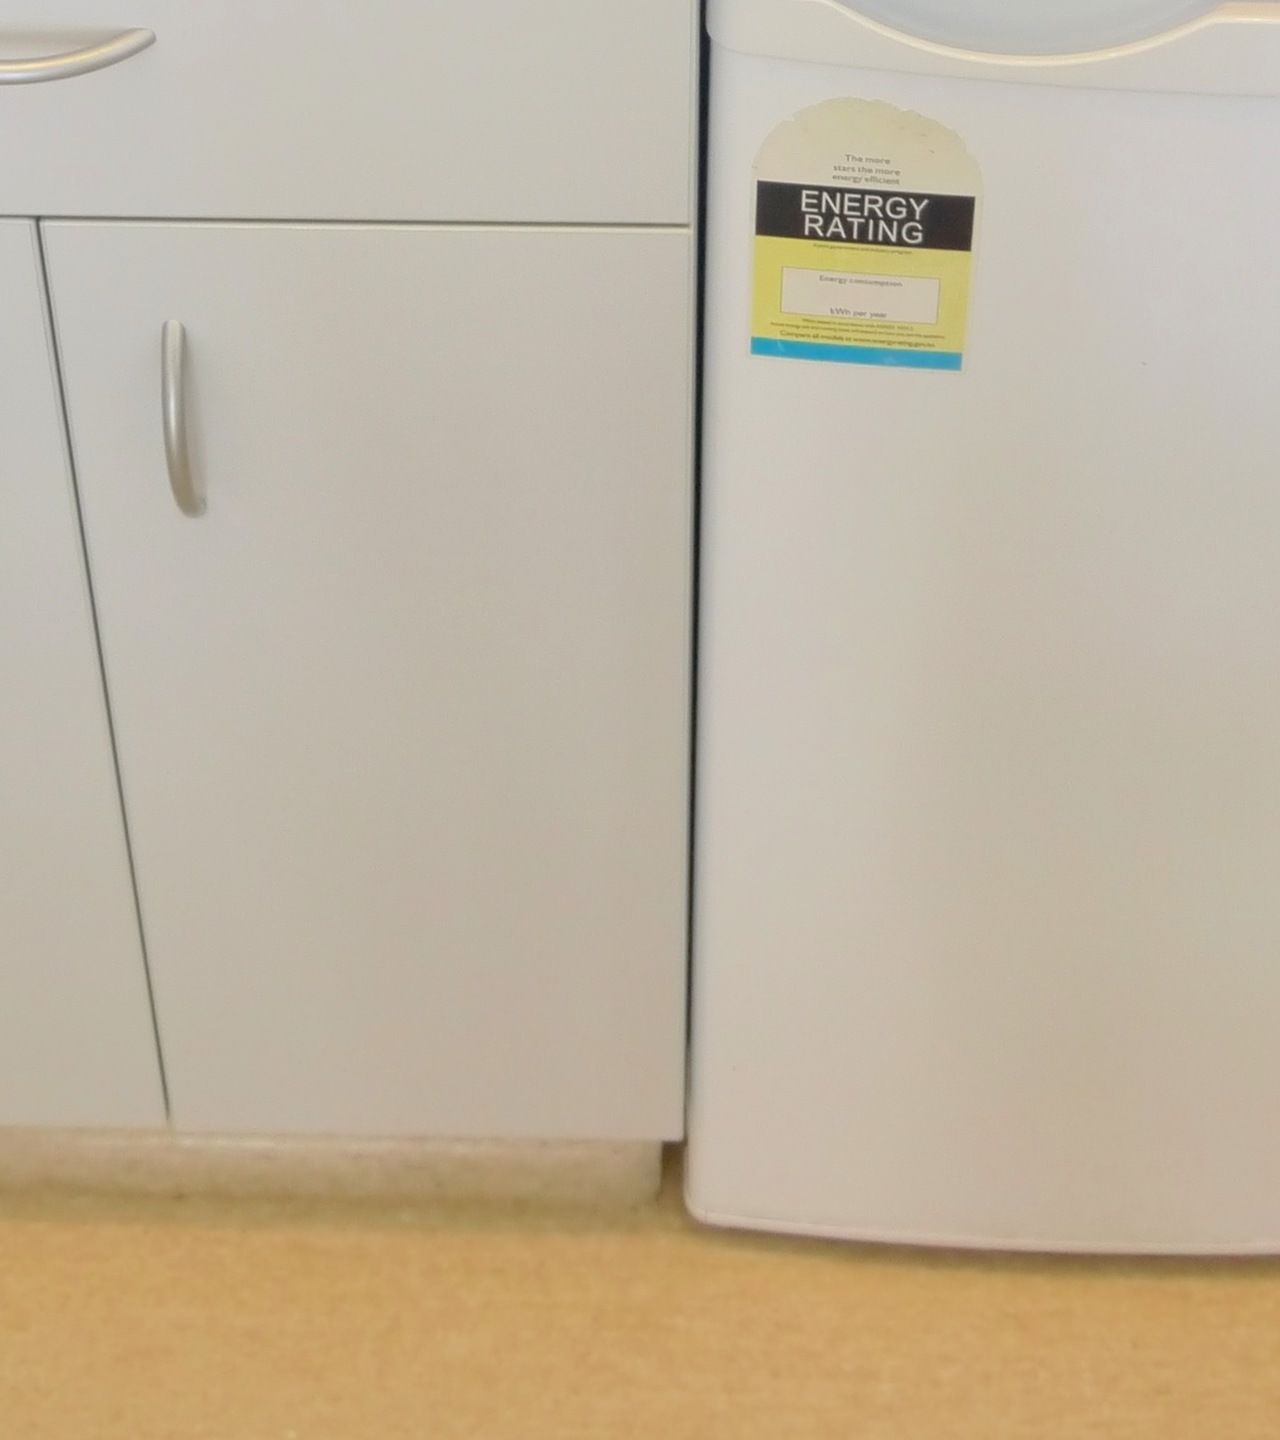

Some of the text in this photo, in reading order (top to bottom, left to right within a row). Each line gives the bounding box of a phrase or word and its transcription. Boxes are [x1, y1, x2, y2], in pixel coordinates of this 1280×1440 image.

[844, 153, 891, 165] The more
[832, 164, 901, 176] stars the more
[832, 173, 863, 184] energy
[800, 189, 929, 221] ENERGY
[803, 213, 924, 244] RATING
[818, 274, 848, 285] Energy
[829, 306, 851, 316] kWh
